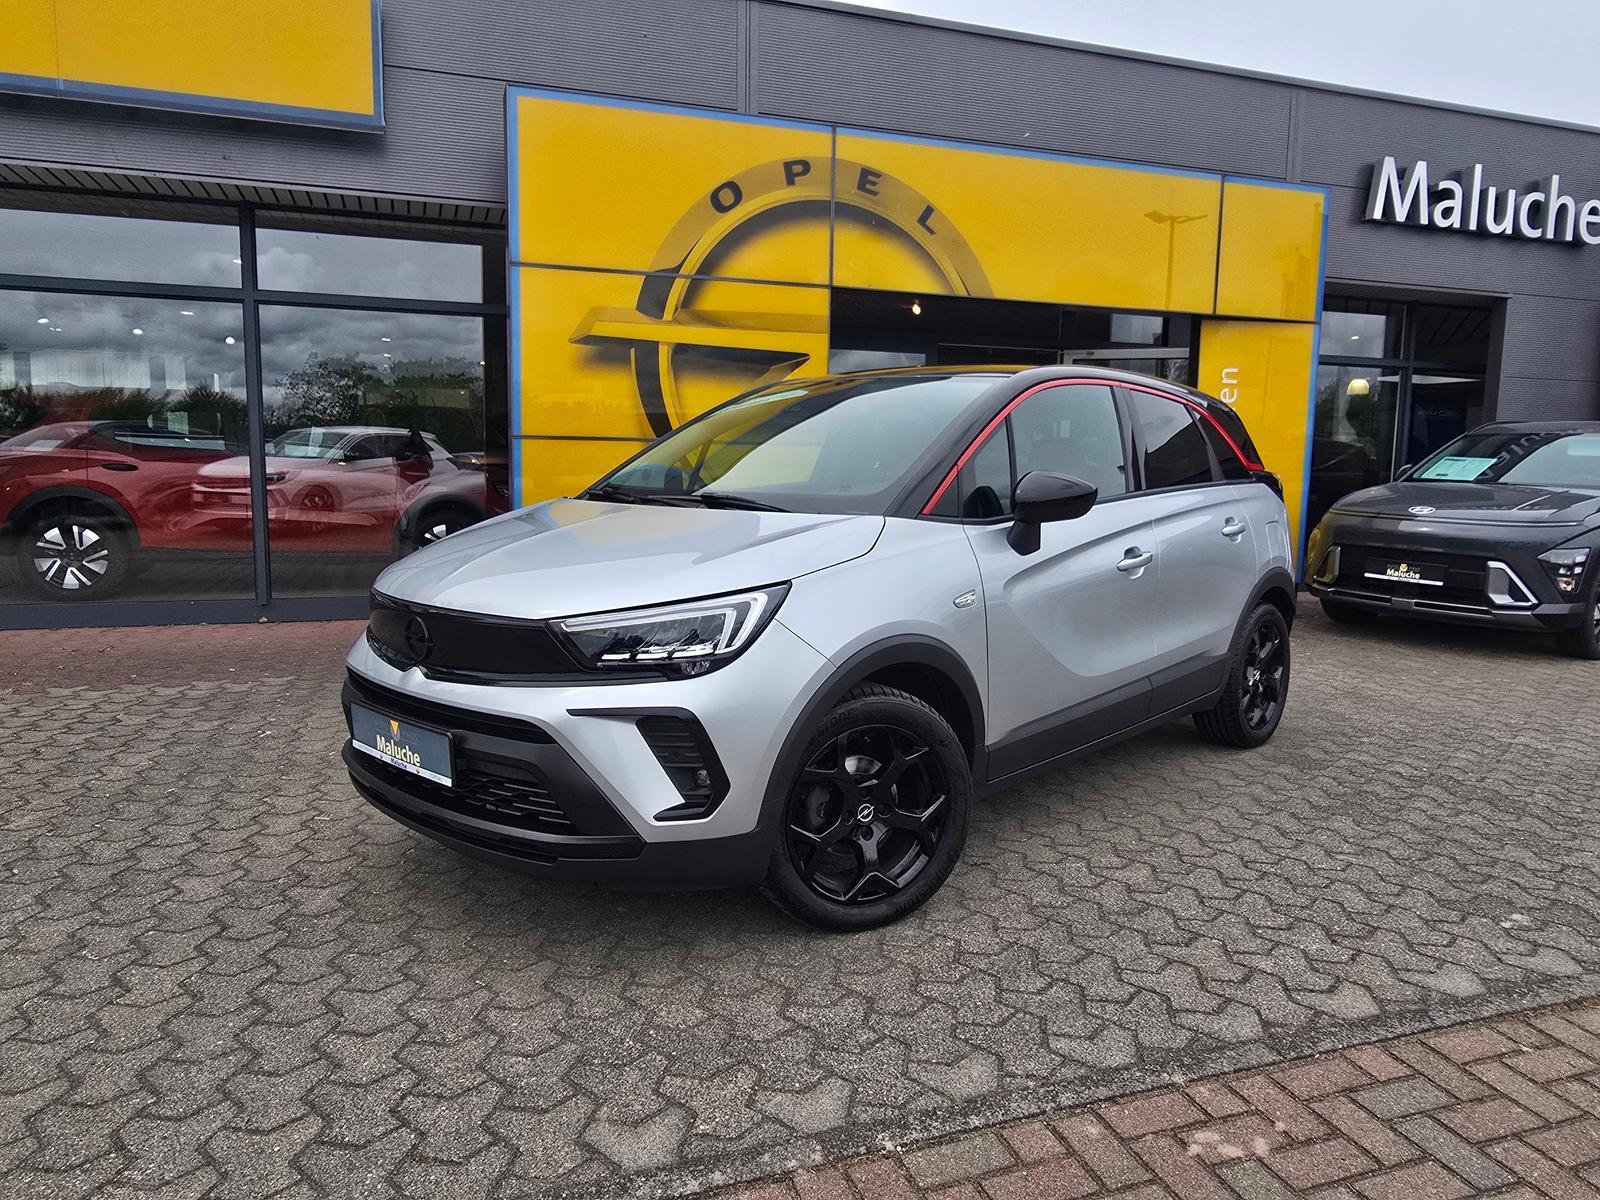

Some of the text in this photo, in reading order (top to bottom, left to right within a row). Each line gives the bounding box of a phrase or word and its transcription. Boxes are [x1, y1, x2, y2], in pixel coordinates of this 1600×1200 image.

[709, 159, 936, 236] OPEL
[1372, 156, 1600, 245] Maluche
[1220, 368, 1238, 404] en
[376, 735, 421, 767] Maluche
